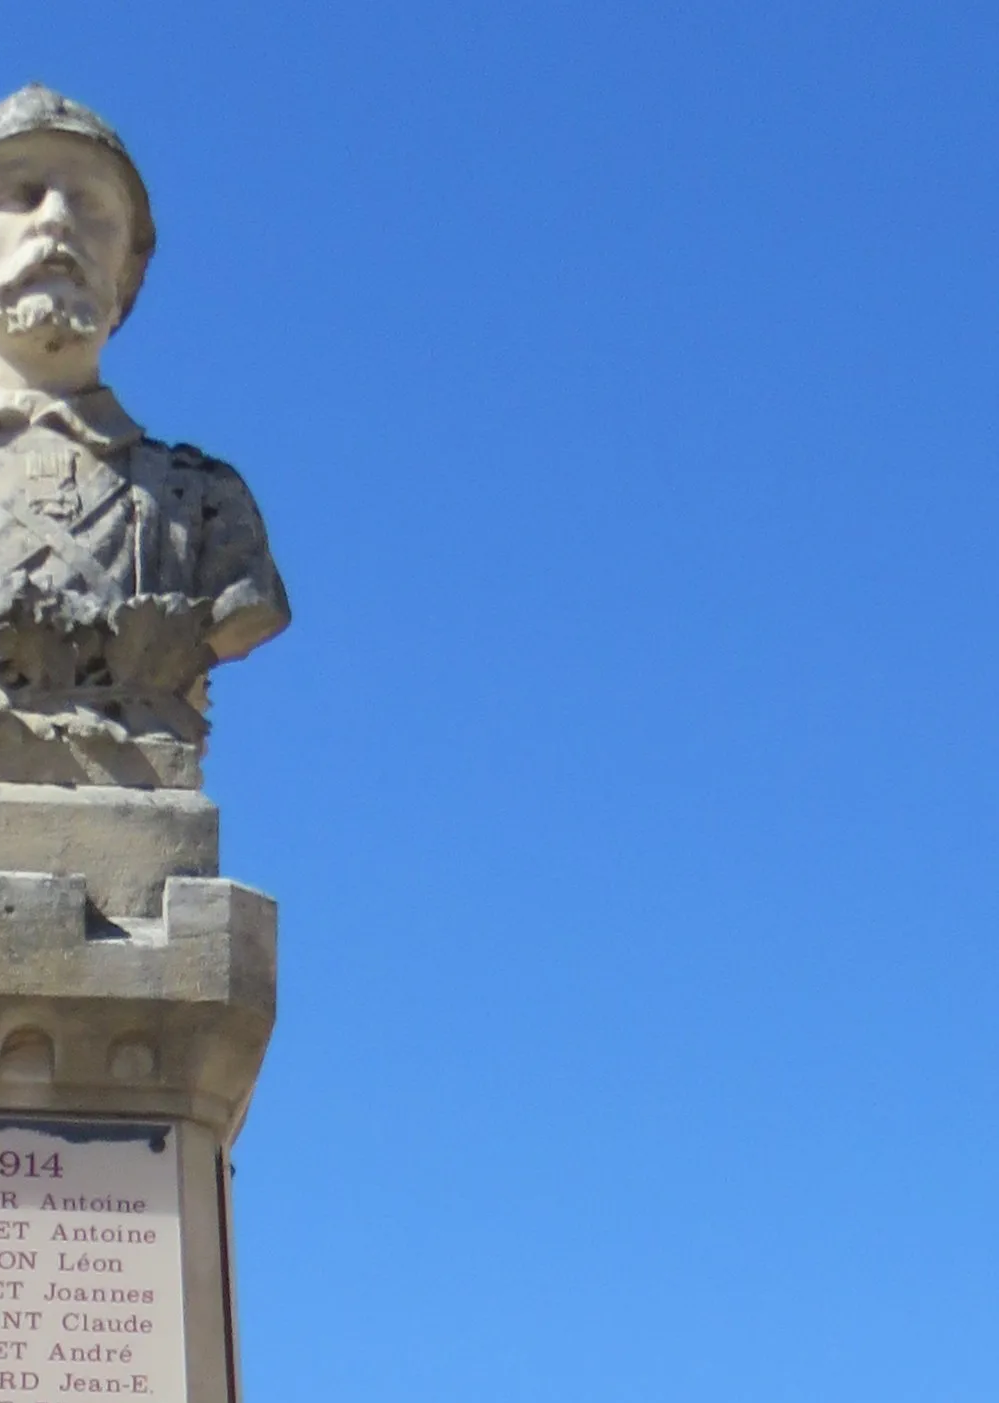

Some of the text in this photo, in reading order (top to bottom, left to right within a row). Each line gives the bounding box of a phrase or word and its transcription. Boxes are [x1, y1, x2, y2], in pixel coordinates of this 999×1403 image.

[40, 1193, 147, 1214] Antoine
[52, 1223, 156, 1243] Antoine
[58, 1253, 123, 1273] Léon
[44, 1284, 153, 1304] Joannes
[63, 1313, 152, 1333] Claude
[49, 1343, 132, 1363] André
